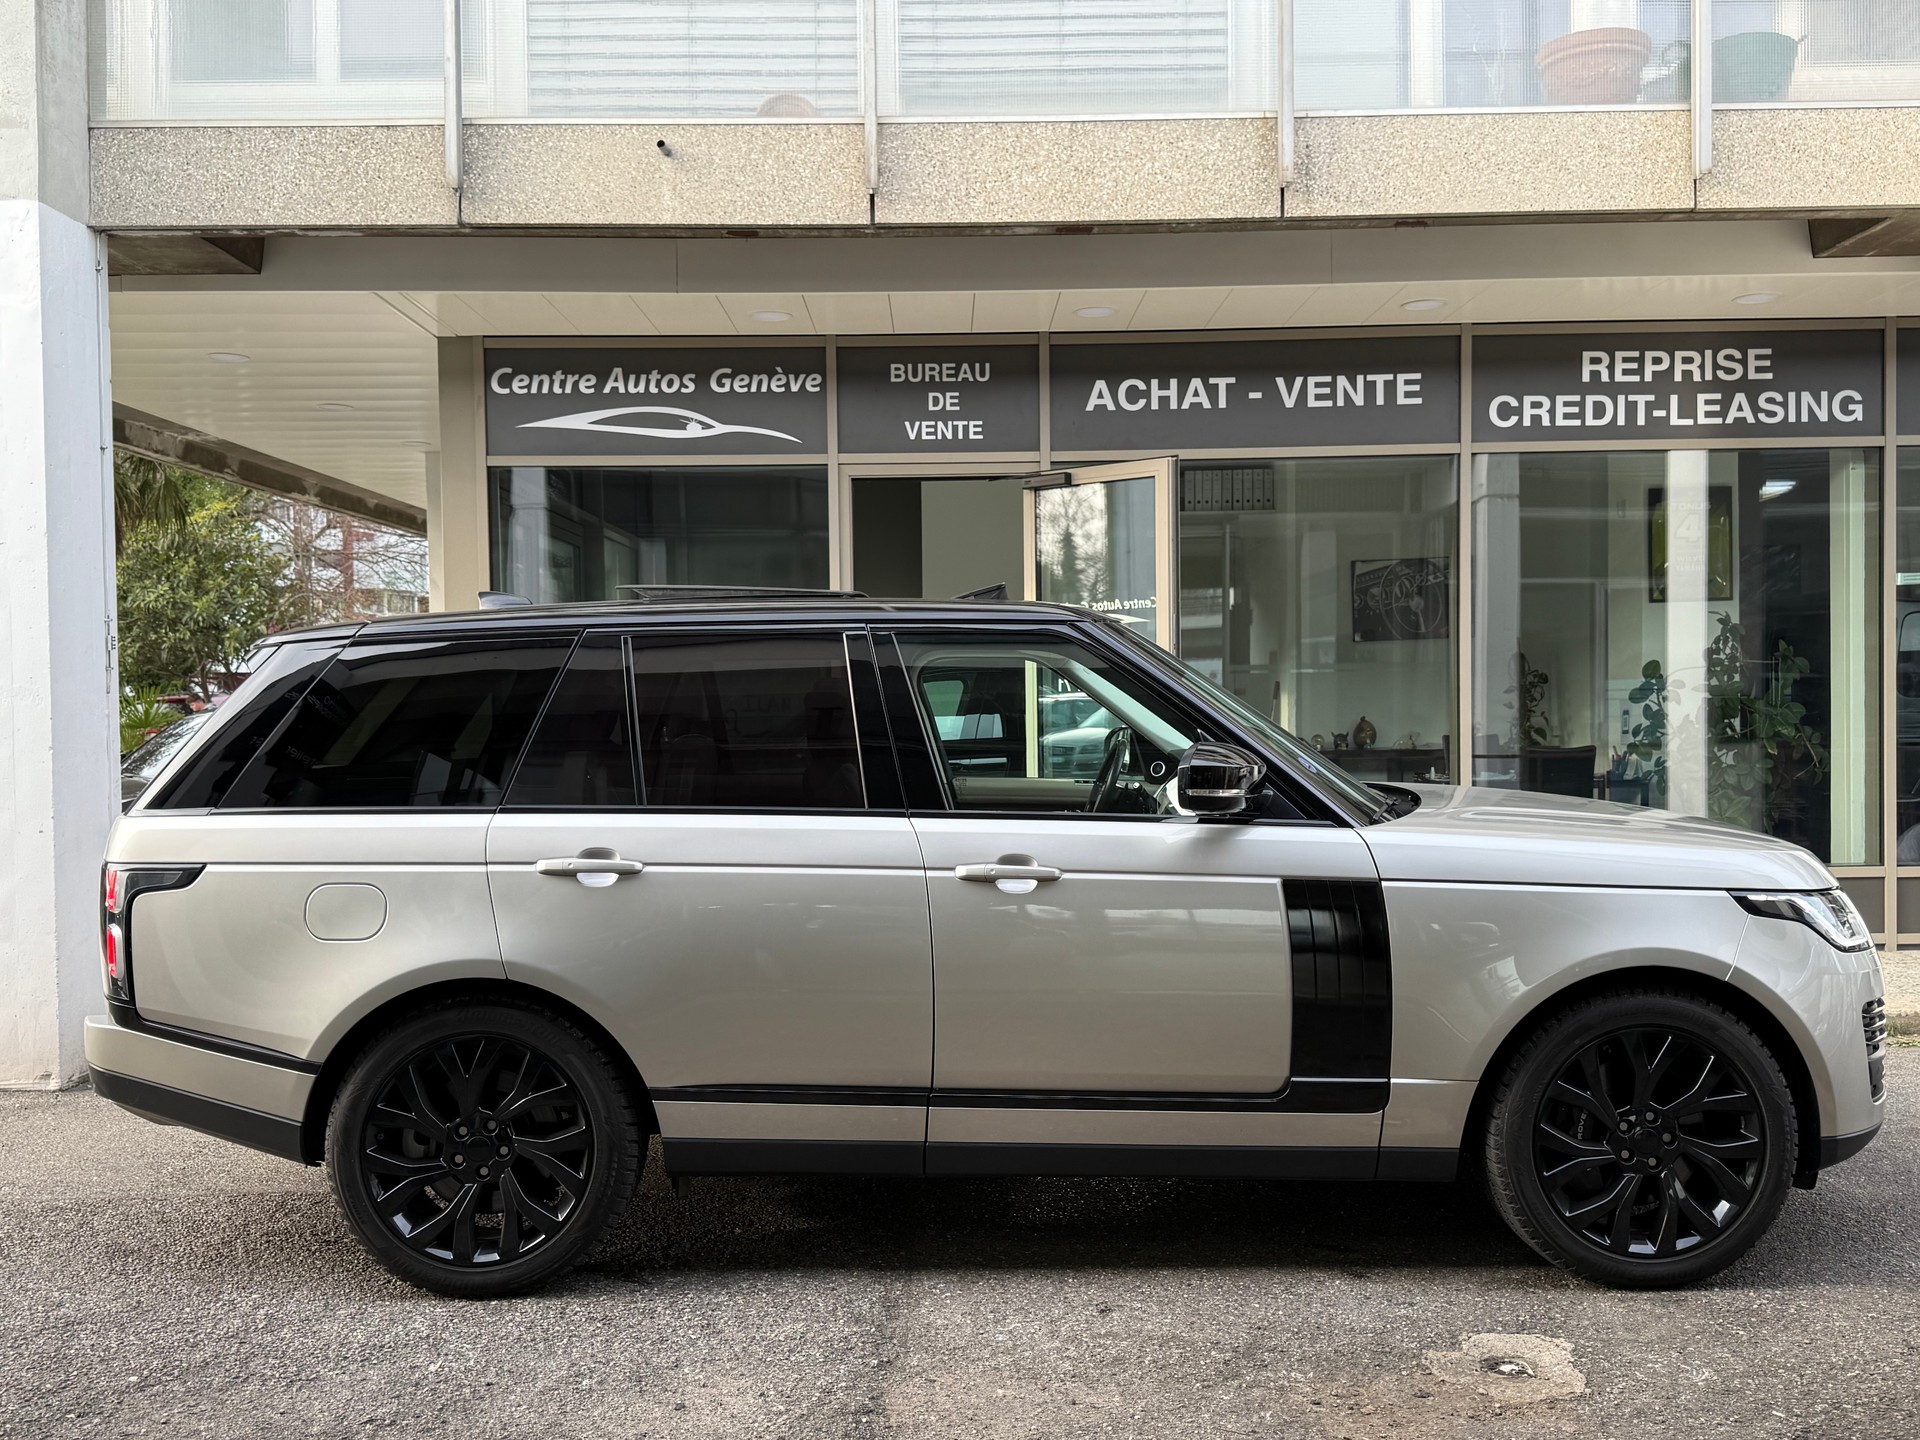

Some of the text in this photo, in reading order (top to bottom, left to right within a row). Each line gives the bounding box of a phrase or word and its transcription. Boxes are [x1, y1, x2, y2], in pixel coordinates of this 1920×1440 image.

[889, 362, 991, 383] BUREAU
[1581, 348, 1774, 383] REPRISE
[490, 366, 822, 395] Centre Autos Genève
[1085, 372, 1423, 412] ACHAT - VENTE
[927, 391, 961, 412] DE
[1487, 389, 1864, 429] CREDIT-LEASING
[903, 420, 984, 441] VENTE
